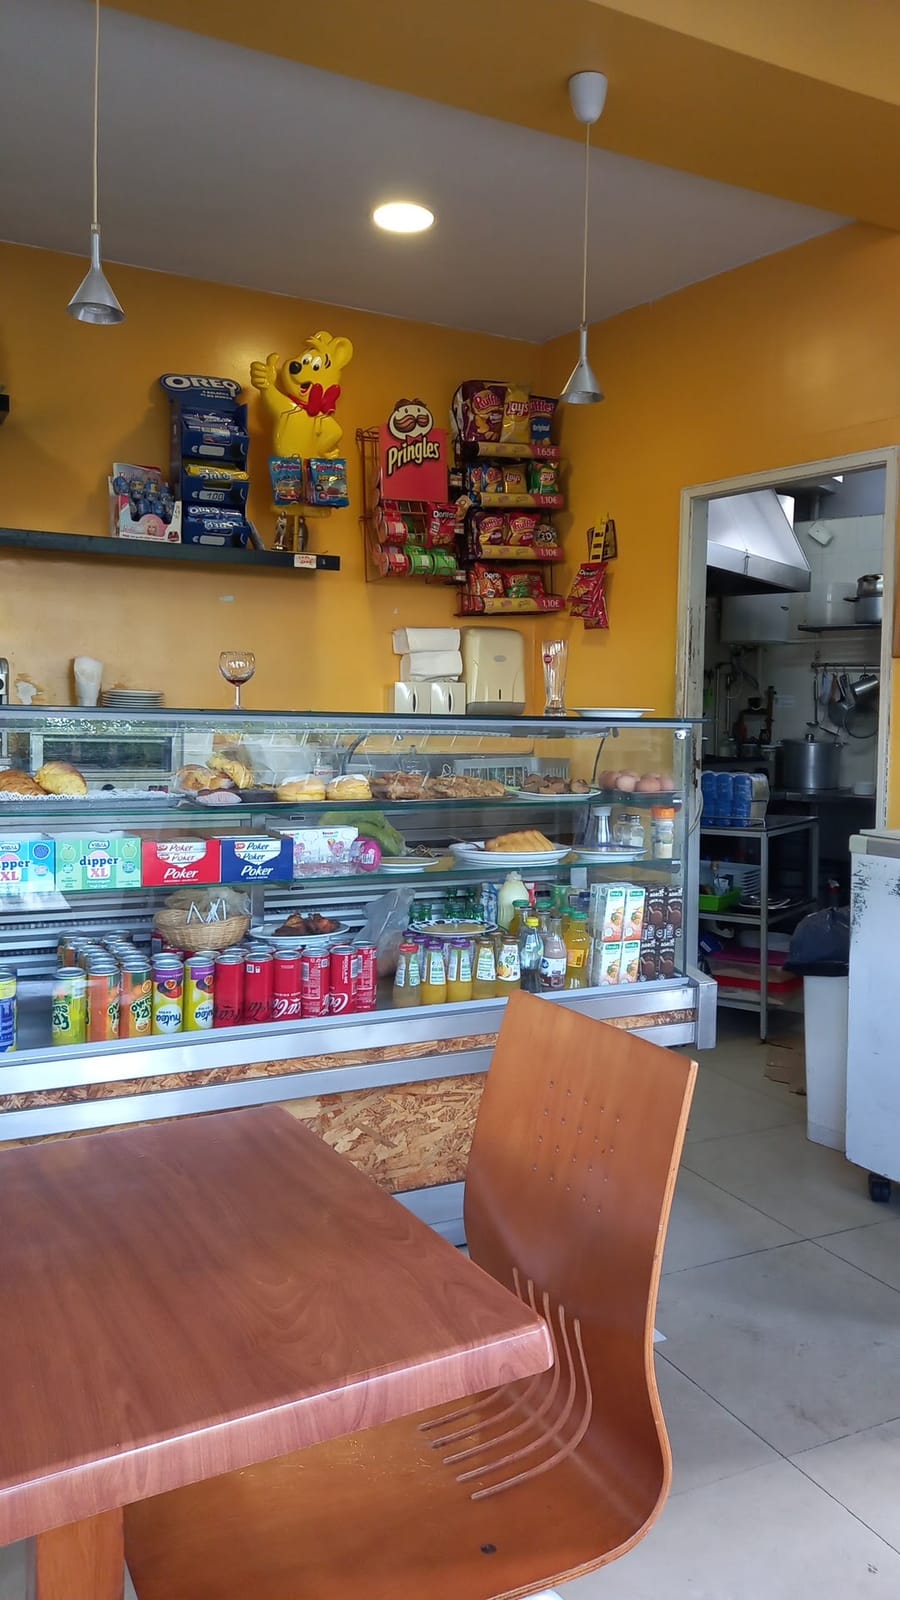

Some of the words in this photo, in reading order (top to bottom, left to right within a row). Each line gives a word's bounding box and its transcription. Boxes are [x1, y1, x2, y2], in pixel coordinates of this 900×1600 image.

[165, 376, 237, 397] OREO
[388, 436, 439, 475] Pringles
[169, 844, 193, 852] Poker
[246, 842, 270, 850] Poker
[80, 856, 119, 868] dipper
[243, 853, 266, 861] Poker
[1, 871, 19, 881] XL
[91, 868, 108, 878] XL
[164, 867, 199, 879] Poker
[241, 865, 274, 877] Poker
